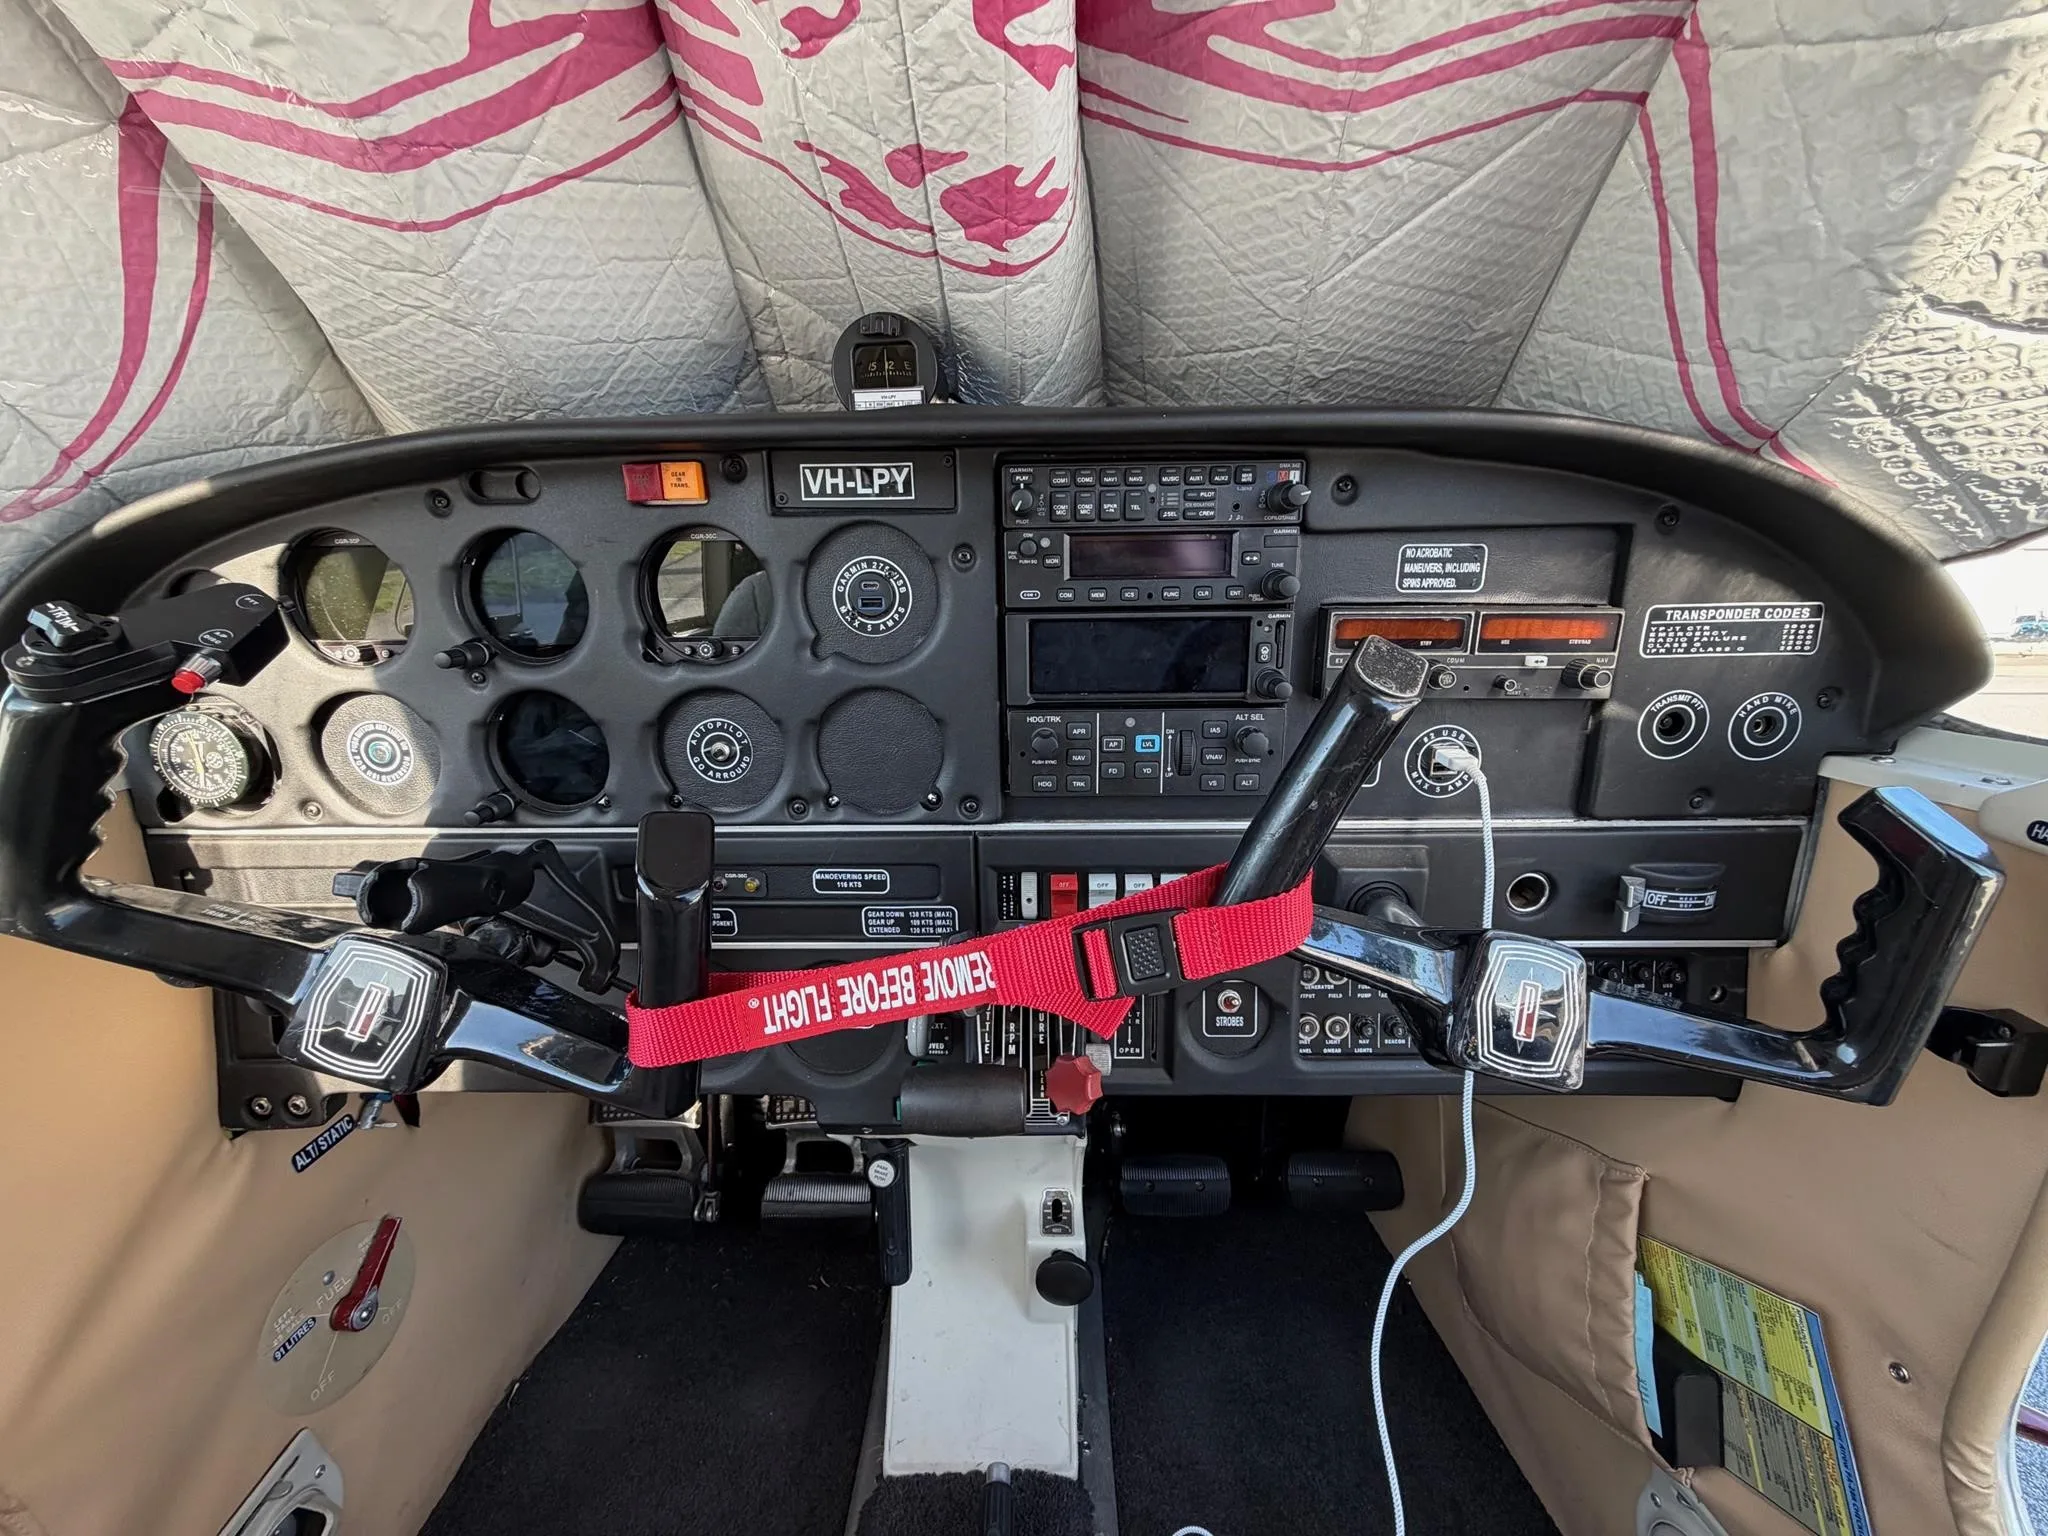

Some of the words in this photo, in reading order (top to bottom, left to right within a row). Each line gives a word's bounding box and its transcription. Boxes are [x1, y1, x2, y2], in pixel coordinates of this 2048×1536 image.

[804, 467, 910, 494] VH-LPY
[1406, 548, 1416, 558] NO
[1416, 548, 1453, 558] ACROBATIC
[837, 562, 868, 592] GARMIN
[1404, 562, 1444, 574] MANEUVERS,
[1445, 562, 1480, 573] INCLUDING
[1402, 578, 1421, 588] SPINS
[1421, 578, 1456, 588] APPROVED.
[50, 605, 76, 629] TRIM
[840, 605, 860, 628] MAX
[880, 606, 905, 631] AMPS
[1665, 607, 1760, 621] TRANSPONDER
[1764, 607, 1811, 619] CODES
[1649, 630, 1729, 638] EMERGENCY
[1650, 694, 1692, 713] TRANSMIT
[1739, 696, 1769, 718] HAND
[1774, 696, 1797, 715] MIKE
[690, 722, 748, 746] AUTOPILOT
[1442, 729, 1466, 741] USB
[353, 756, 367, 771] FOR
[381, 756, 410, 783] REVERSION
[693, 756, 705, 770] GO
[707, 756, 750, 779] ARROUND
[1410, 771, 1430, 790] MAX
[815, 873, 863, 881] MANOEVERING
[864, 872, 886, 880] SPEED
[1648, 893, 1668, 906] OFF
[919, 951, 997, 1002] REMOVE
[836, 965, 917, 1018] BEFORE
[1215, 1016, 1244, 1027] STROBES
[1008, 1023, 1016, 1055] RPM
[294, 1143, 319, 1170] ALT/
[318, 1116, 353, 1151] STATIC
[316, 1277, 352, 1310] FUEL
[274, 1347, 286, 1360] 91
[285, 1318, 316, 1350] LITRES
[310, 1370, 336, 1401] OFF
